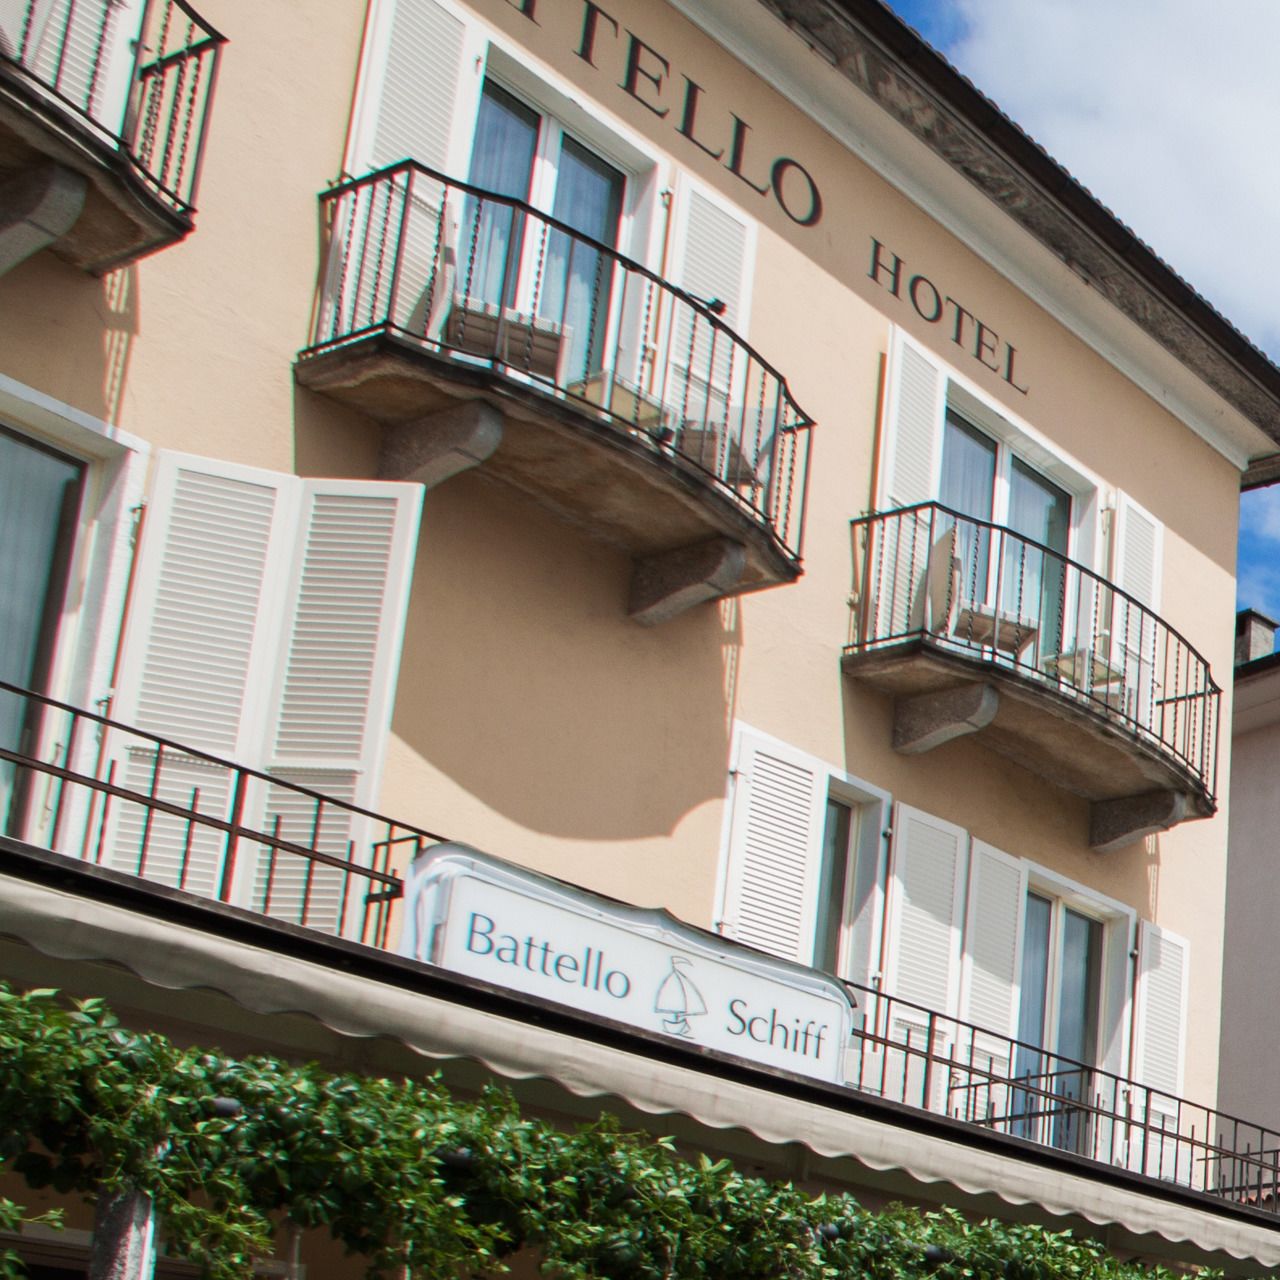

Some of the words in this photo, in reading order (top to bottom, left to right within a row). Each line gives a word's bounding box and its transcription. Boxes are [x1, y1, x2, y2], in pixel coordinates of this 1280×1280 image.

[505, 0, 823, 227] TELLO
[866, 235, 1031, 396] HOTEL
[465, 911, 633, 999] Battello
[726, 998, 829, 1060] Schiff
